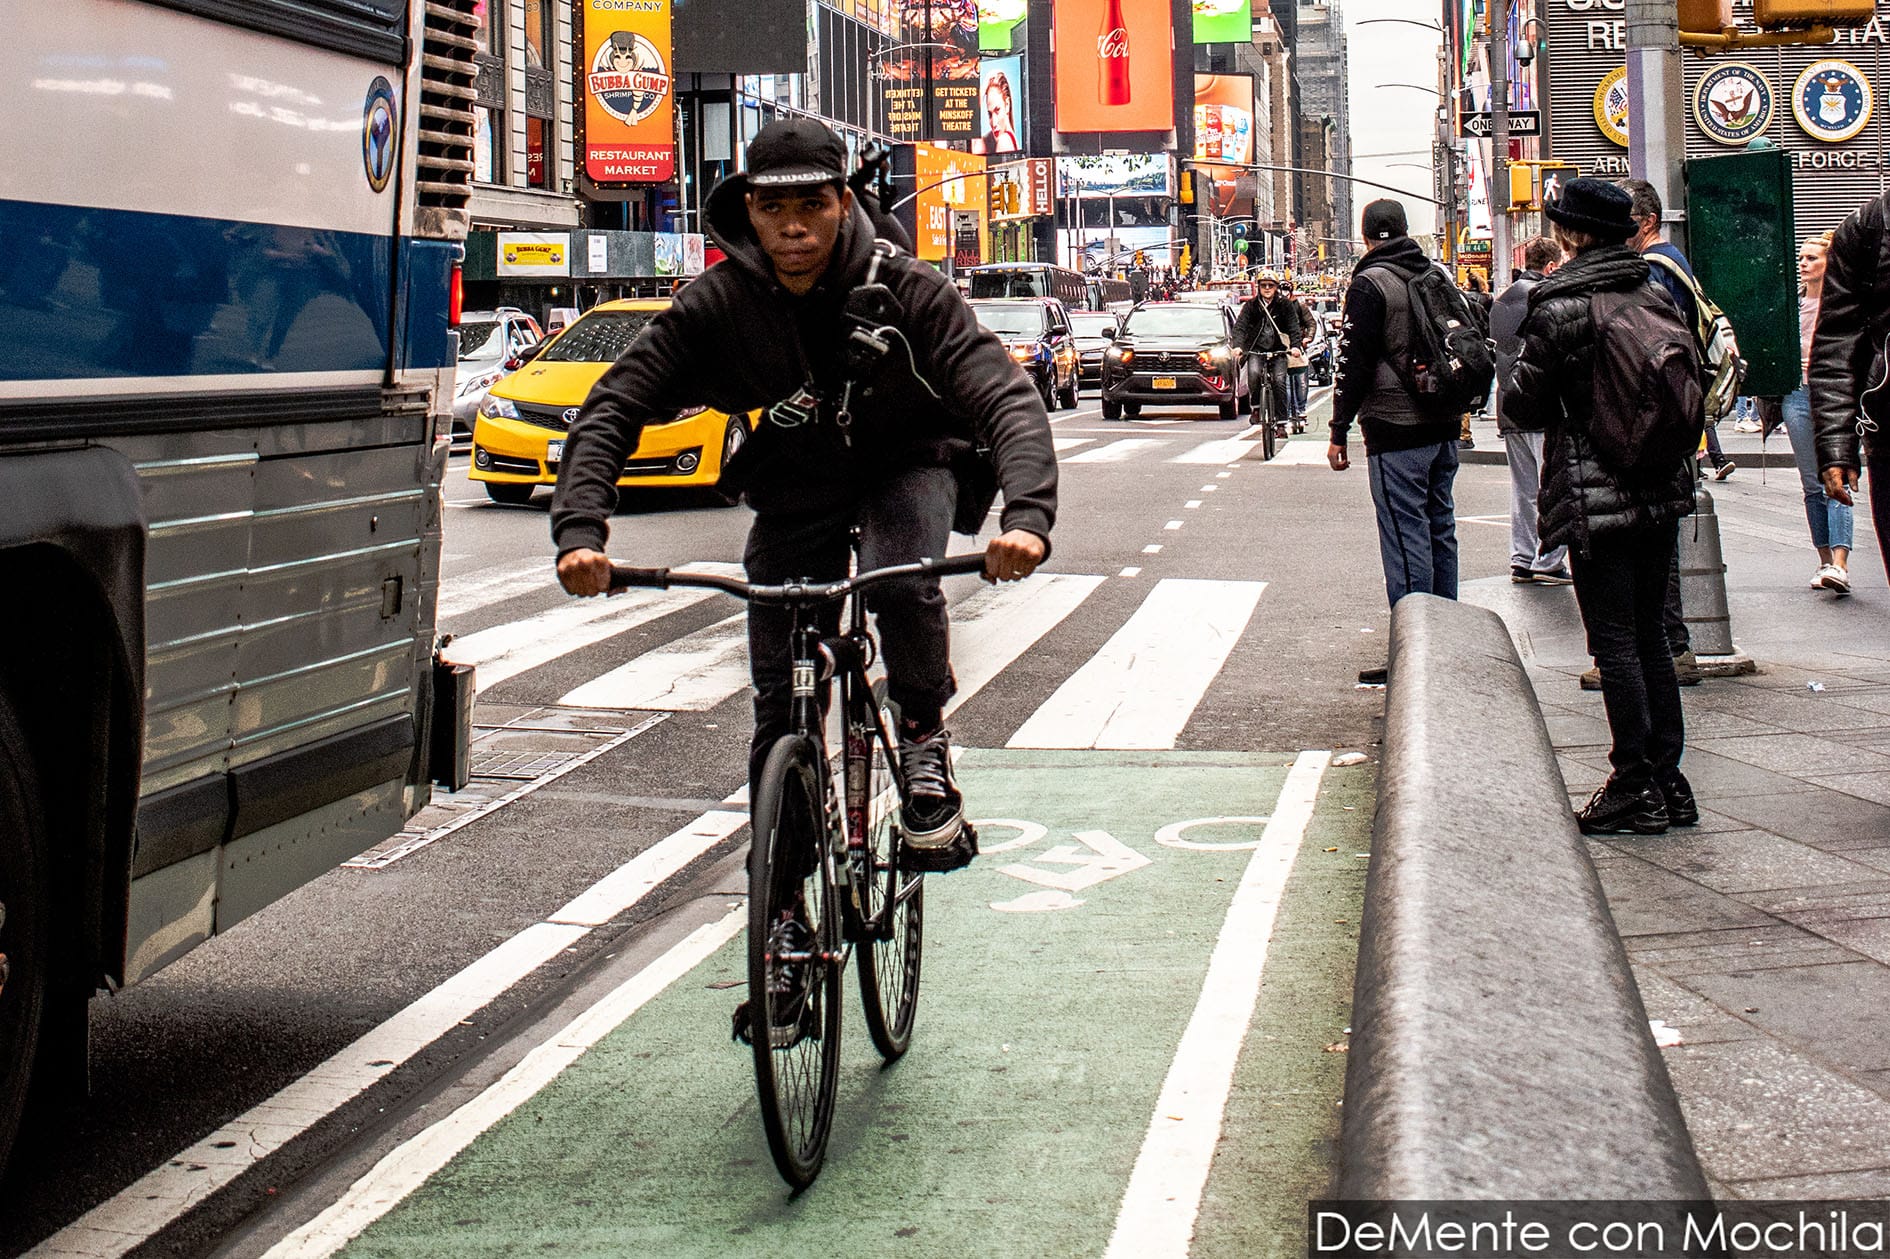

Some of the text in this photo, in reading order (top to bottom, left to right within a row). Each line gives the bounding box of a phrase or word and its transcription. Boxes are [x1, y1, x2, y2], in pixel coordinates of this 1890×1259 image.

[592, 0, 662, 12] COMPANY
[591, 72, 667, 92] BUBBA GUMP
[603, 91, 633, 100] SHRIMP
[935, 87, 977, 97] GET TICKETS
[944, 98, 968, 109] AT THE
[939, 109, 974, 120] MINSKOFF
[941, 121, 972, 132] THEATRE
[590, 150, 671, 161] RESTAURANT
[1592, 156, 1630, 172] ARM
[604, 165, 658, 175] MARKET
[1035, 161, 1048, 213] HELLO!
[957, 250, 978, 259] ALL
[956, 257, 980, 267] RISE
